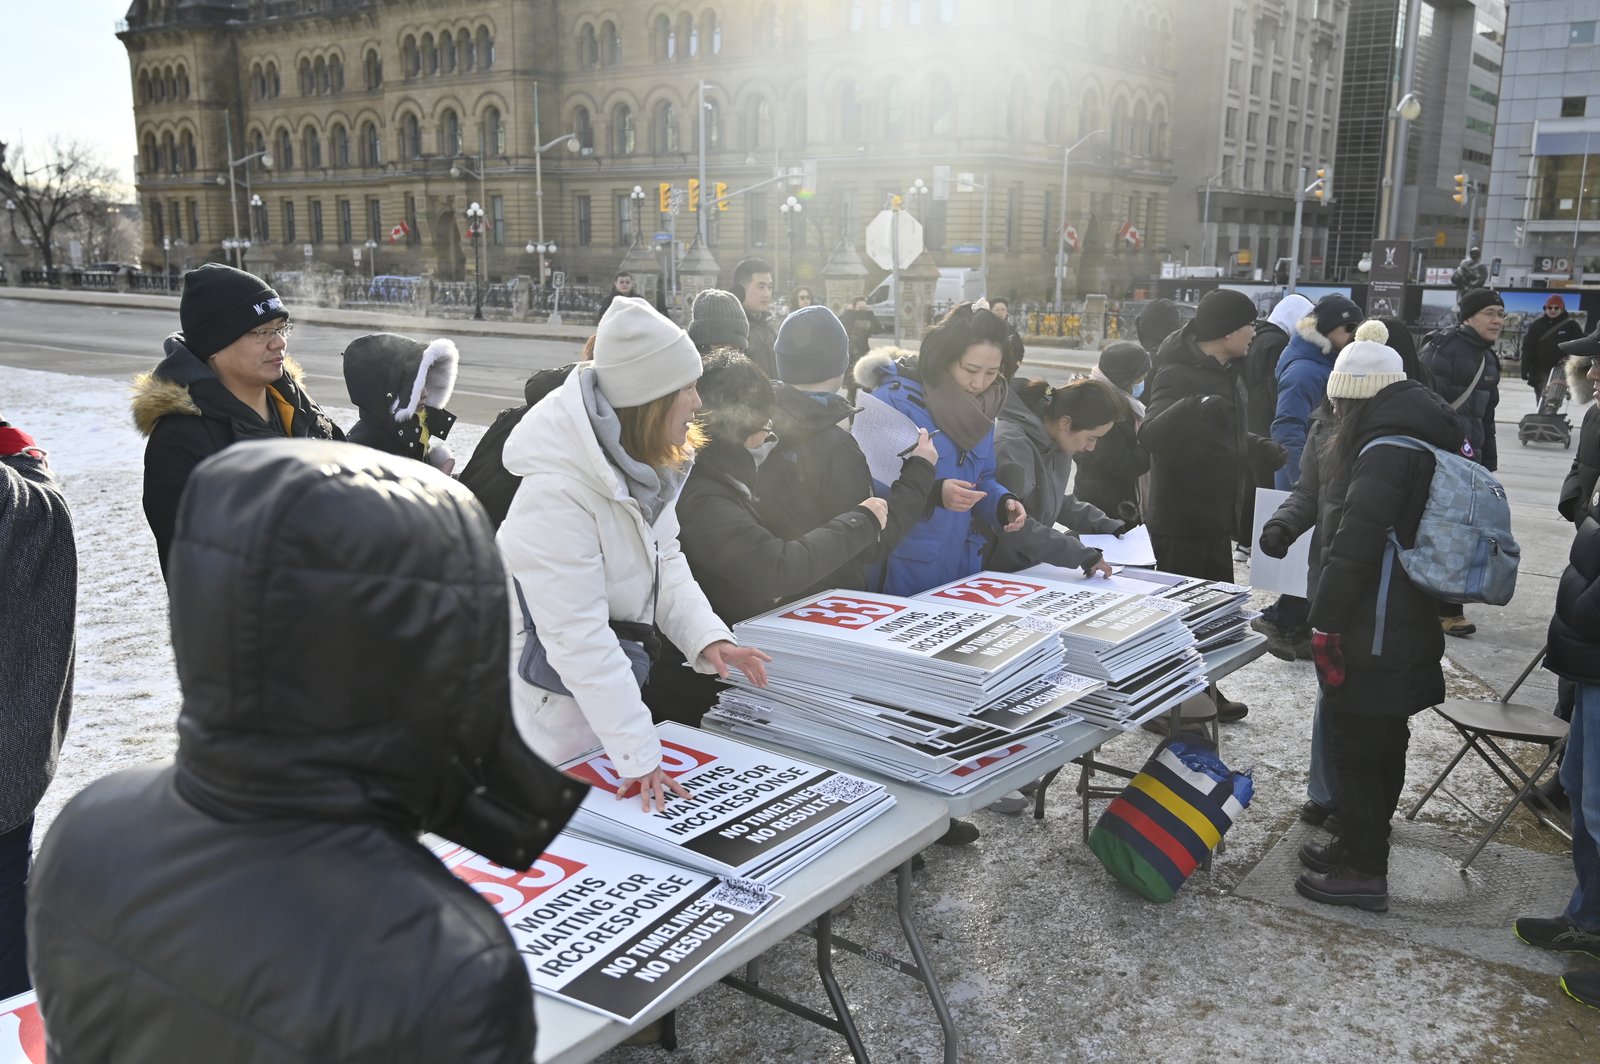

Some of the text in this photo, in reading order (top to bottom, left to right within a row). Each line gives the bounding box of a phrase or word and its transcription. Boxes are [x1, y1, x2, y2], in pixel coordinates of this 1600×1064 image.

[1542, 258, 1568, 271] 90
[943, 579, 1036, 605] 23
[1015, 590, 1066, 610] MONTHS
[1066, 592, 1123, 617] RESPONSE
[1068, 590, 1098, 601] FOR
[792, 599, 896, 626] 33
[874, 611, 929, 634] MONTHS
[1085, 619, 1107, 629] NO
[887, 611, 964, 643] WAITING FOR
[907, 612, 992, 652] IRCC RESPONSE
[1107, 622, 1129, 631] NO
[955, 643, 979, 655] NO
[980, 646, 1004, 657] NO
[1008, 704, 1034, 715] NO
[653, 764, 777, 820] WAITING FOR
[665, 766, 809, 836] IRCC RESPONSE
[718, 823, 750, 839] NO
[745, 796, 838, 844] NO RESULTS
[512, 877, 606, 933] MONTHS
[521, 873, 655, 957] WAITING FOR
[536, 874, 694, 978] IRCC RESPONSE
[601, 899, 715, 979] NO TIMELINES
[634, 910, 734, 983] NO RESULTS
